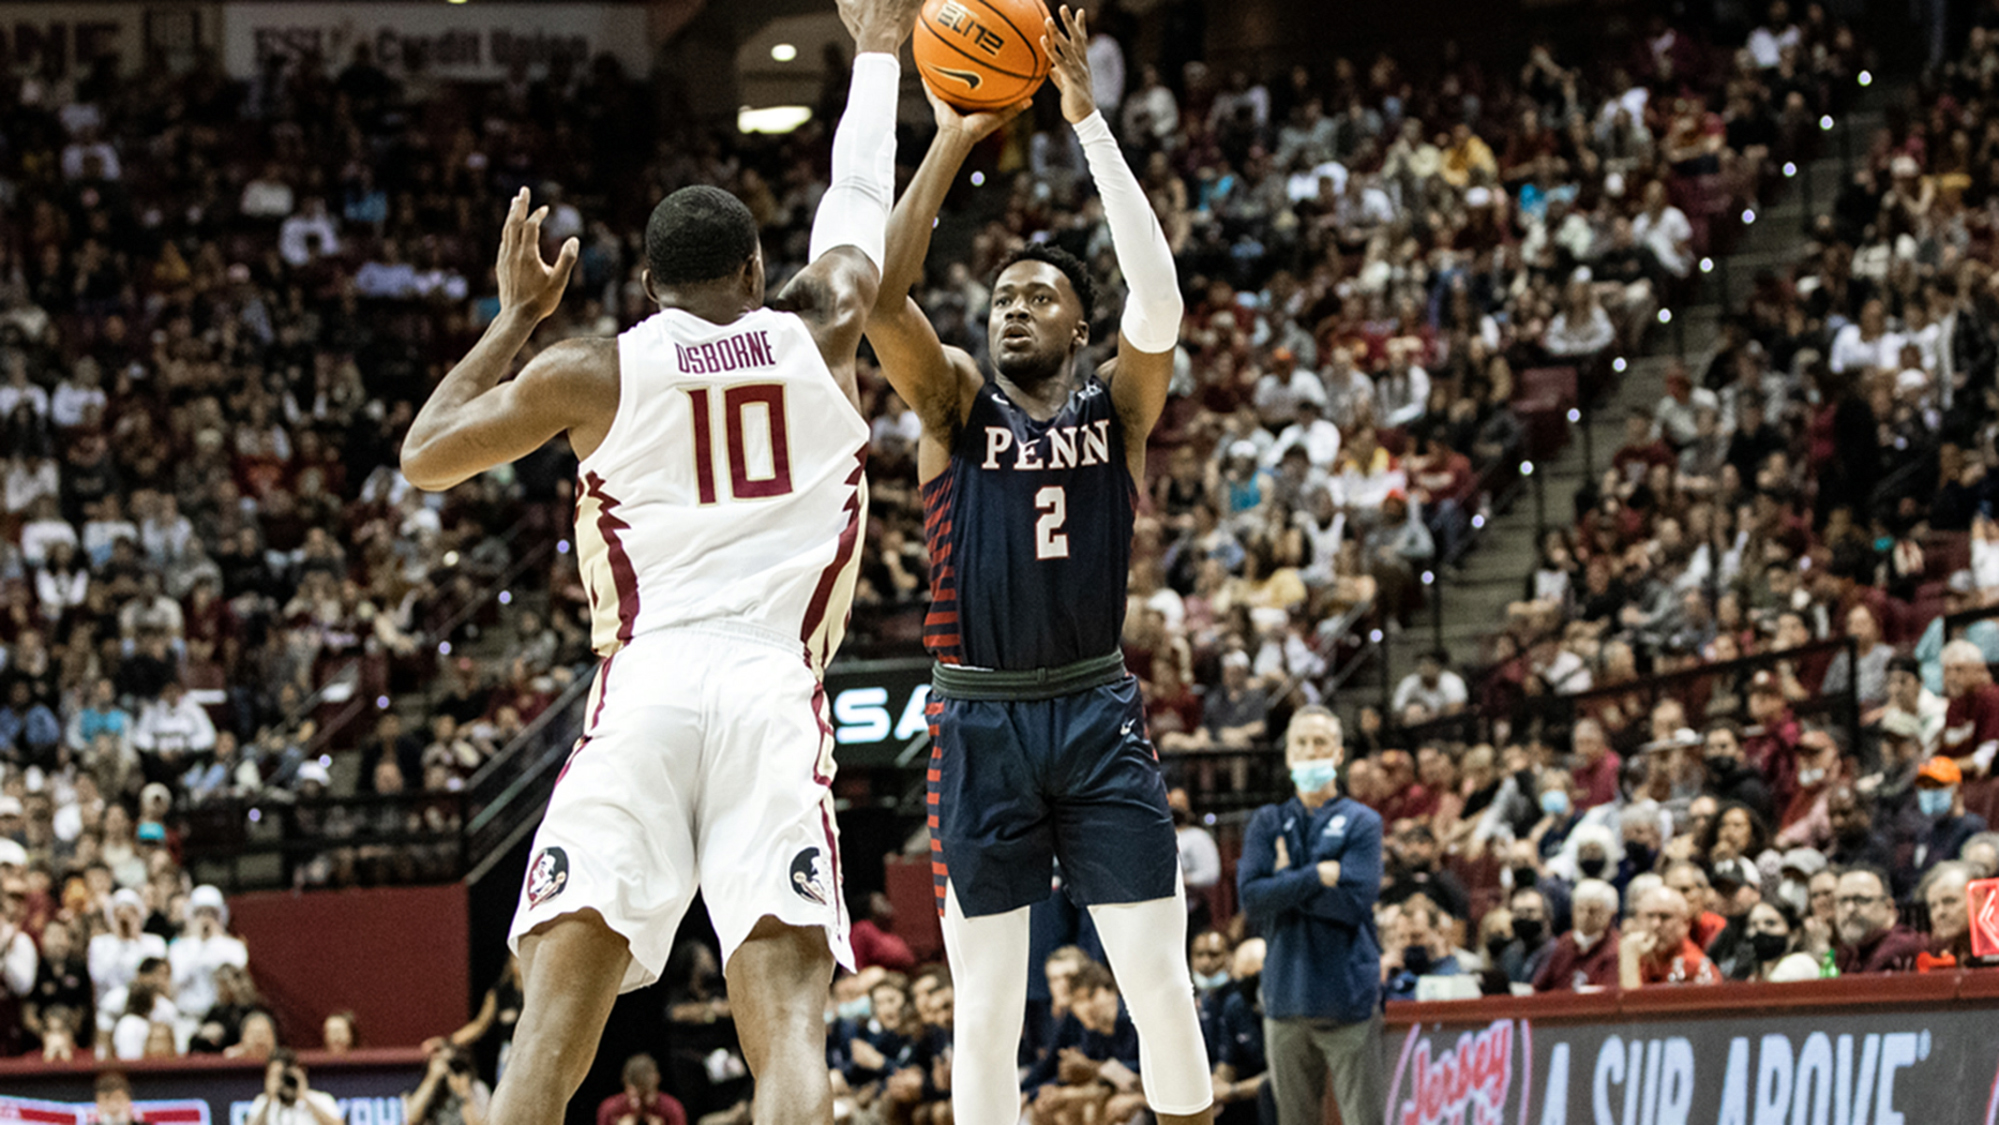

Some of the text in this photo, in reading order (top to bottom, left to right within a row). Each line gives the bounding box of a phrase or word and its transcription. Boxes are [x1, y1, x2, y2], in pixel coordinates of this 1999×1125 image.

[938, 4, 1005, 57] ELITE
[674, 330, 776, 375] OSBORNE
[680, 381, 793, 506] 10
[981, 418, 1110, 470] PENN
[1034, 485, 1070, 560] 2
[1539, 1041, 1571, 1125] A
[1717, 1030, 1918, 1125] ABOVE
